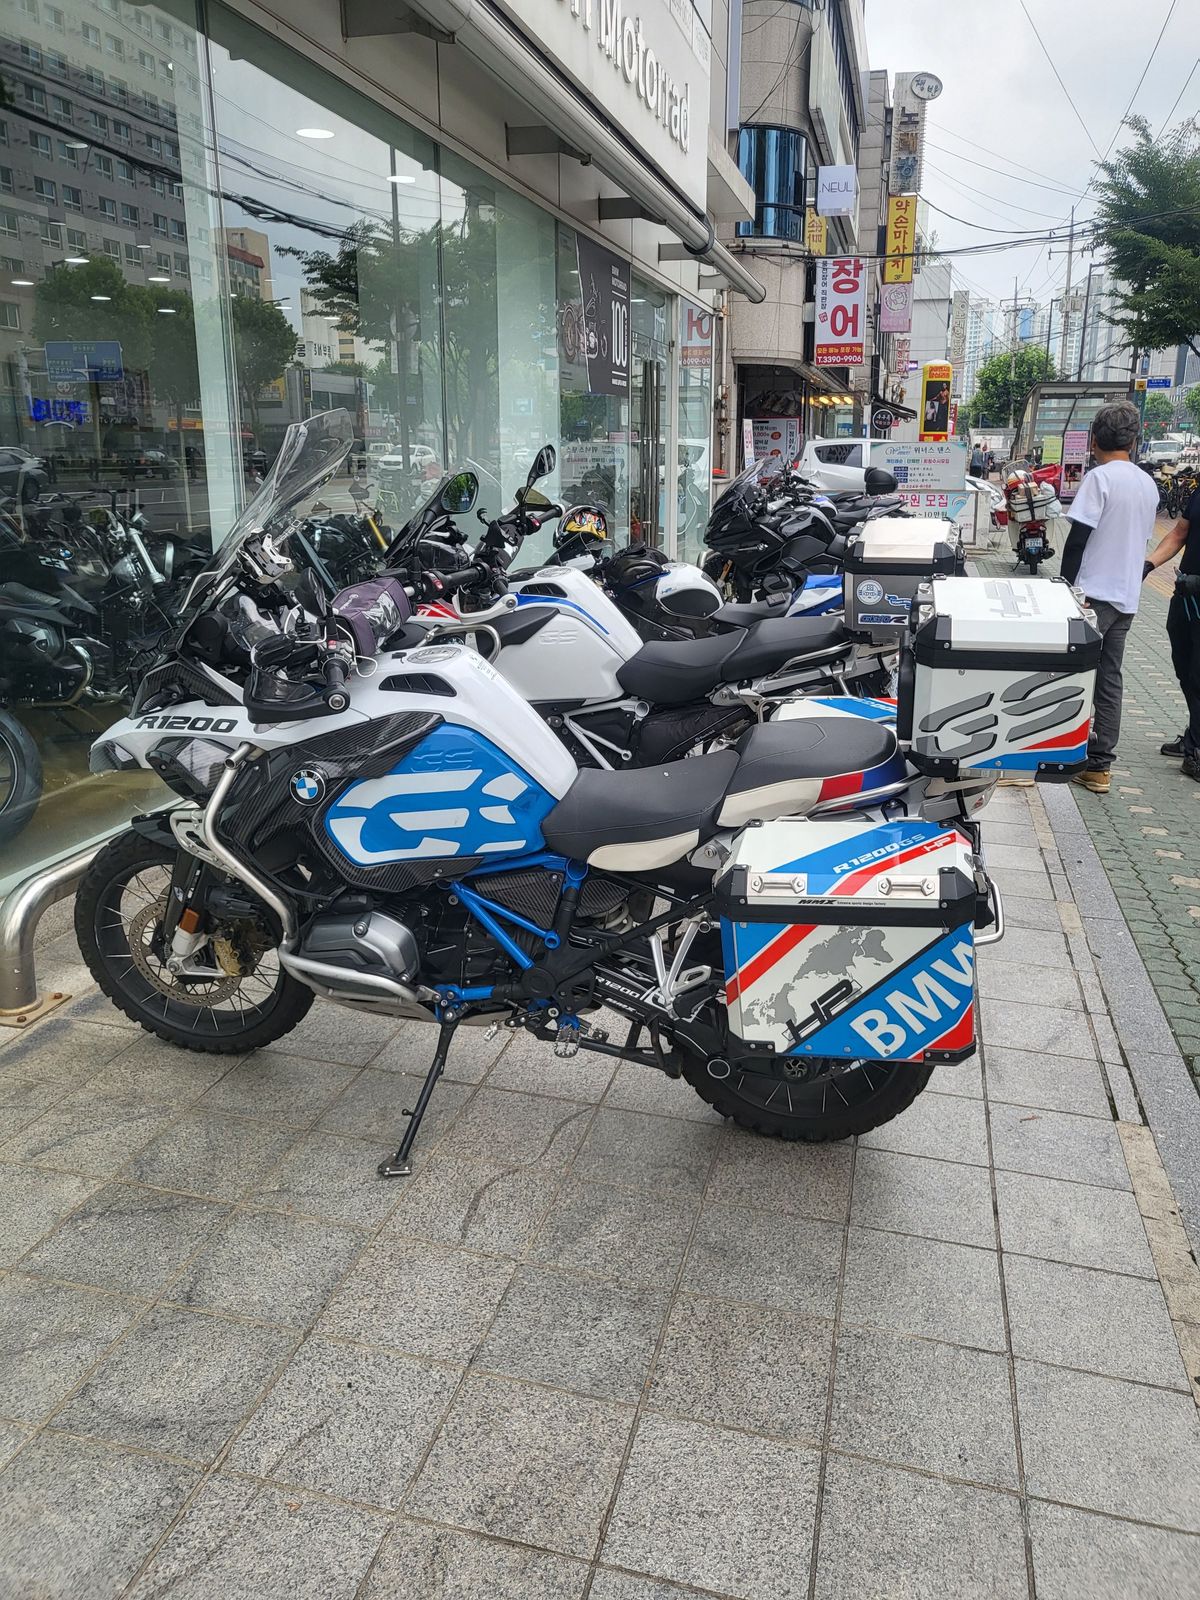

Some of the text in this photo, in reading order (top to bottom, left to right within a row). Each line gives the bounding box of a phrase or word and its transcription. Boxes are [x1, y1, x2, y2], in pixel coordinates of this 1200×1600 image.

[597, 0, 690, 153] Motorrad
[890, 199, 911, 273] 약손마사지
[829, 258, 863, 337] 장어
[817, 355, 863, 364] T.3390-9906
[925, 495, 949, 508] 모집
[135, 715, 239, 734] R1200
[595, 975, 640, 999] R1200
[781, 979, 863, 1041] HP
